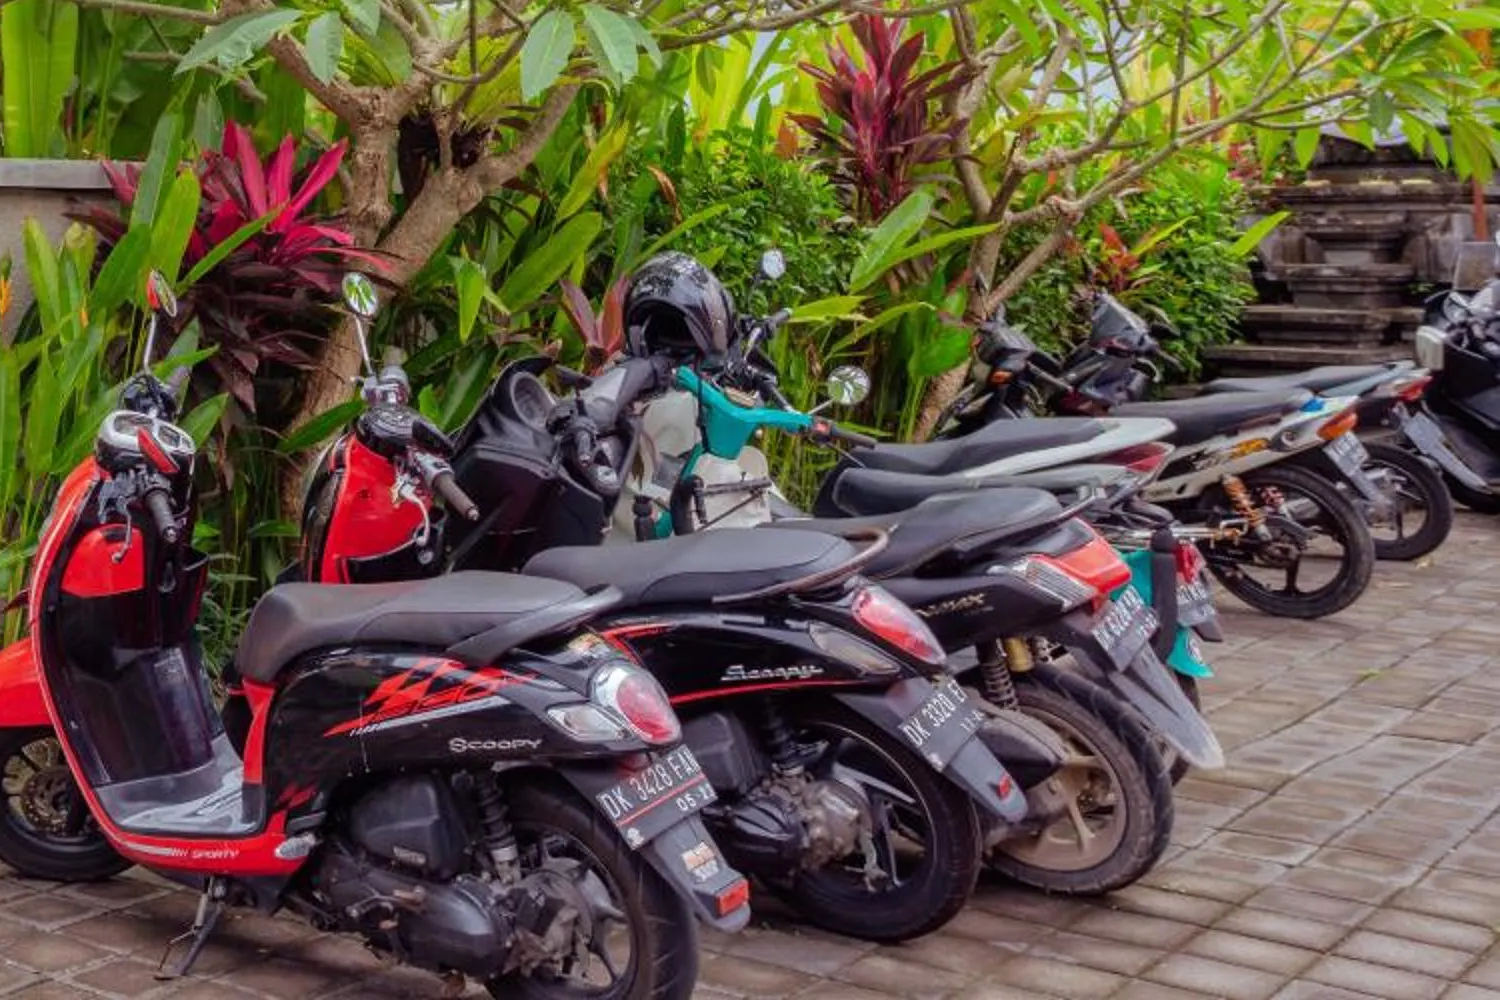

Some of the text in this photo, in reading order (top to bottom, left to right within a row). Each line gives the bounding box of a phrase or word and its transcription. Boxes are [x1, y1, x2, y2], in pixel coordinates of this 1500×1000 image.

[903, 716, 931, 746] DK
[922, 693, 956, 727] 3320
[601, 787, 633, 818] DK
[628, 764, 673, 800] 3428
